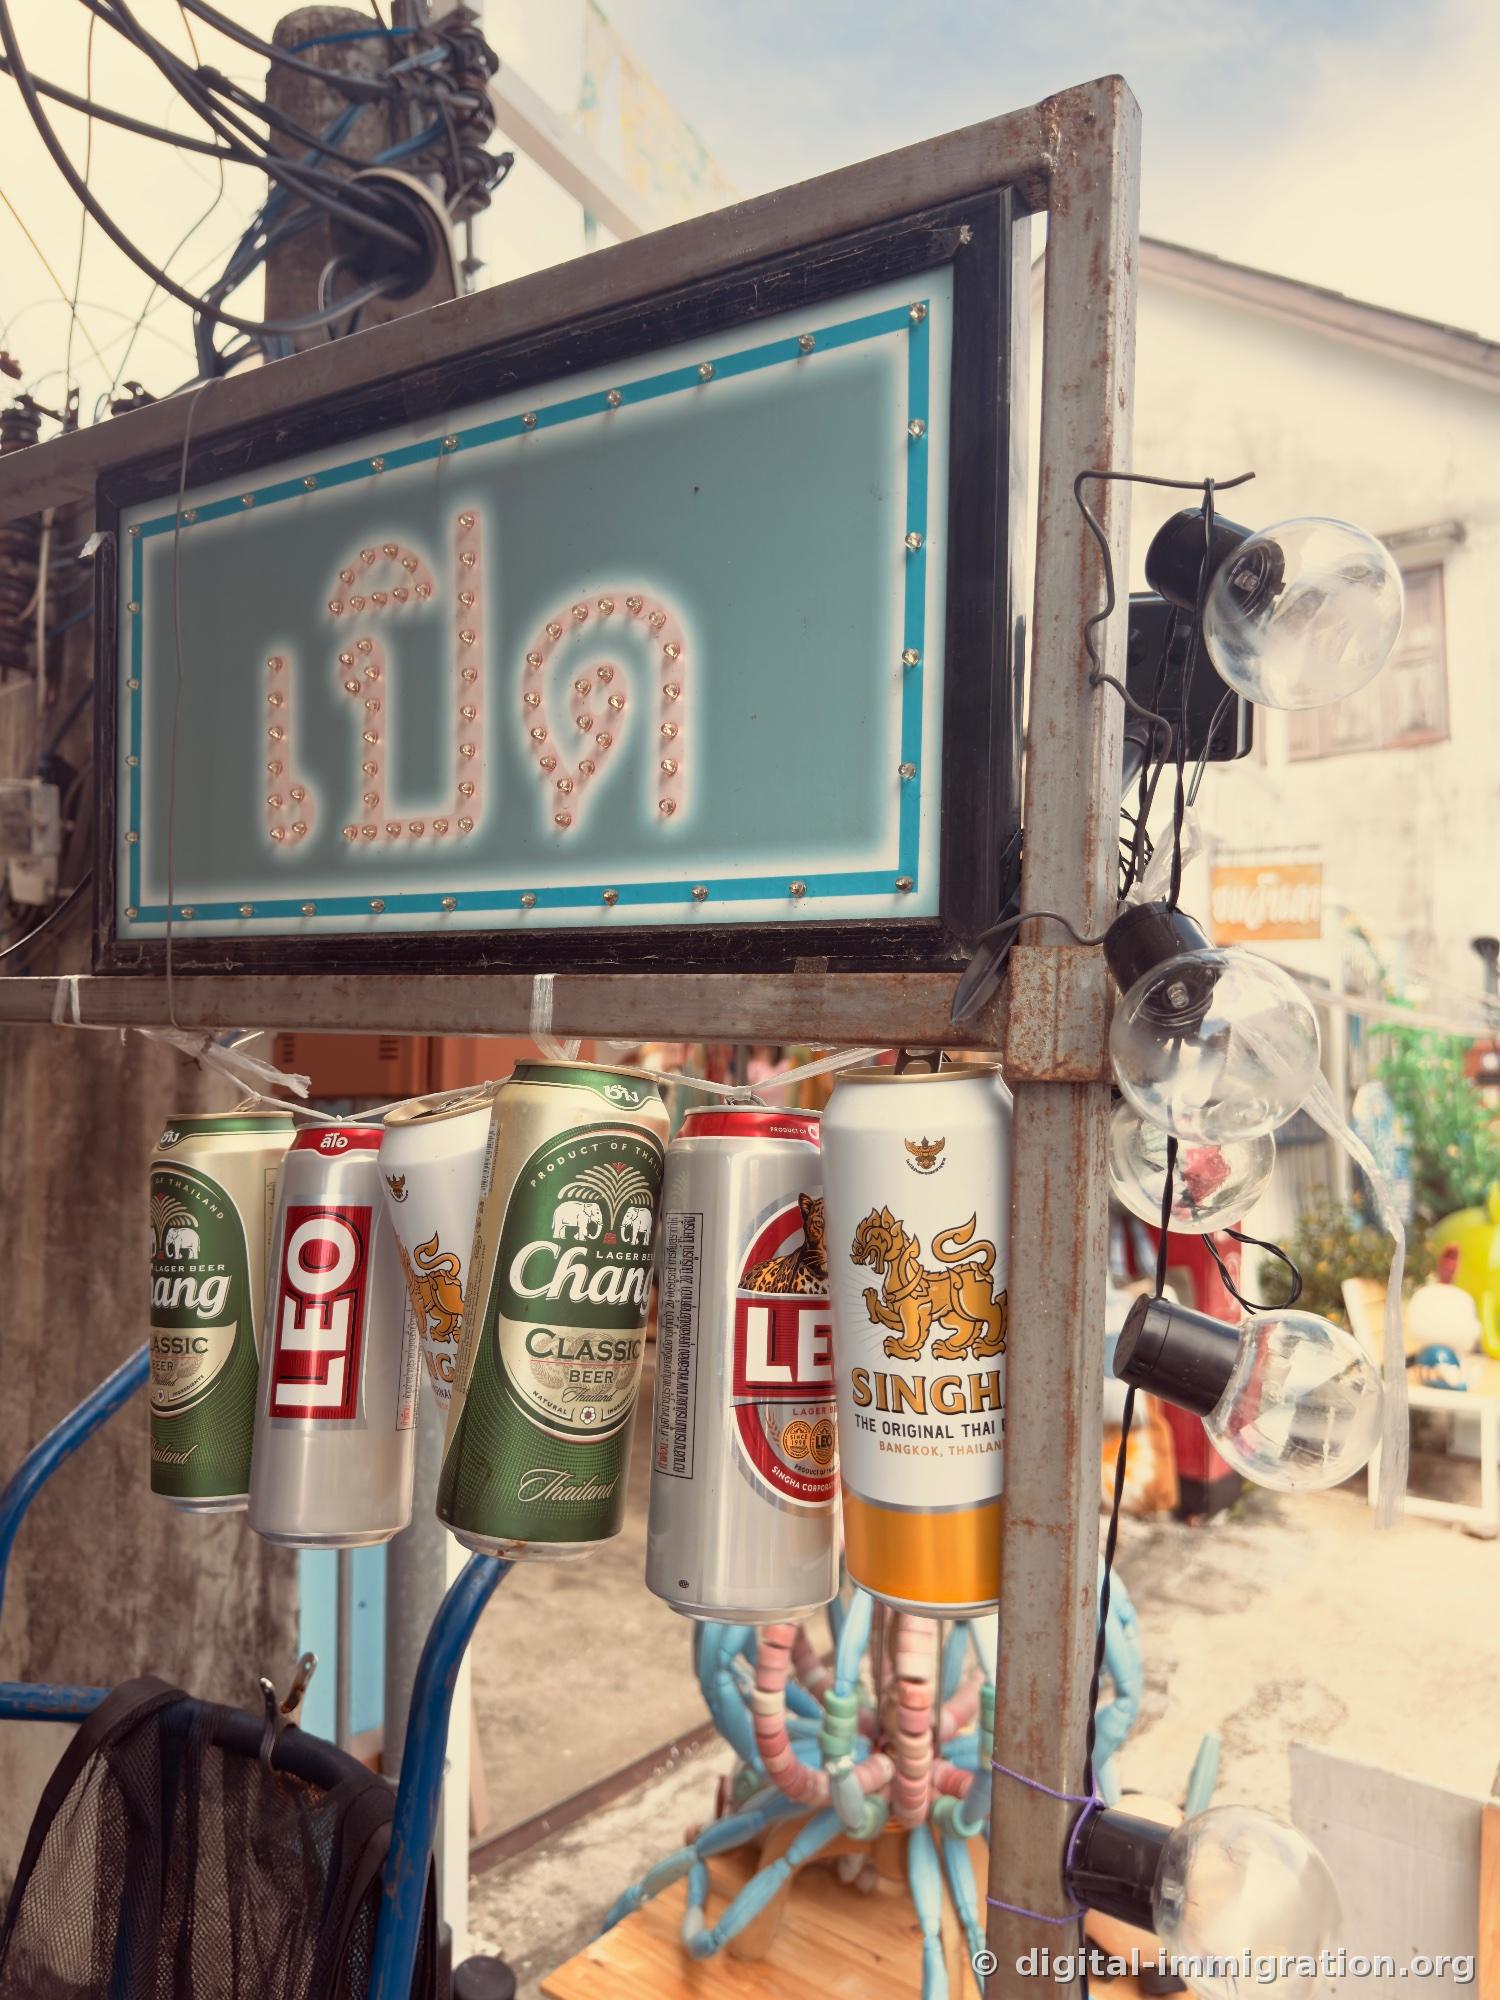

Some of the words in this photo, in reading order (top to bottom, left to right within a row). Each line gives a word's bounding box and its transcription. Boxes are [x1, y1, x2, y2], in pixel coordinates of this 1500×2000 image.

[263, 510, 686, 846] เปิด
[320, 1132, 349, 1148] ลีโอ
[770, 1126, 798, 1134] PRODUCT
[530, 1143, 599, 1188] PRODUCT
[610, 1142, 628, 1151] OF
[635, 1146, 660, 1180] THAIL
[169, 1178, 224, 1219] THAILAND
[155, 1264, 185, 1272] LAGER
[189, 1263, 226, 1272] BEER
[596, 1250, 639, 1261] LAGER
[151, 1275, 232, 1320] ang
[275, 1217, 357, 1408] LEO
[151, 1335, 209, 1354] ASSIC
[525, 1327, 642, 1362] CLASSIC
[745, 1306, 832, 1382] LE
[568, 1369, 615, 1384] BEER
[532, 1390, 568, 1416] NATURAL
[851, 1367, 1005, 1416] SINGH
[792, 1406, 827, 1416] LAGER
[855, 1413, 877, 1433] THE
[882, 1420, 955, 1439] ORIGINAL
[961, 1420, 996, 1438] THAI
[815, 1434, 833, 1450] LEO
[879, 1440, 944, 1458] BANGKOK,
[771, 1465, 801, 1489] SINGHA
[802, 1482, 833, 1492] CORPORA
[794, 1463, 820, 1475] PRODUCT
[517, 1468, 621, 1502] Thailand
